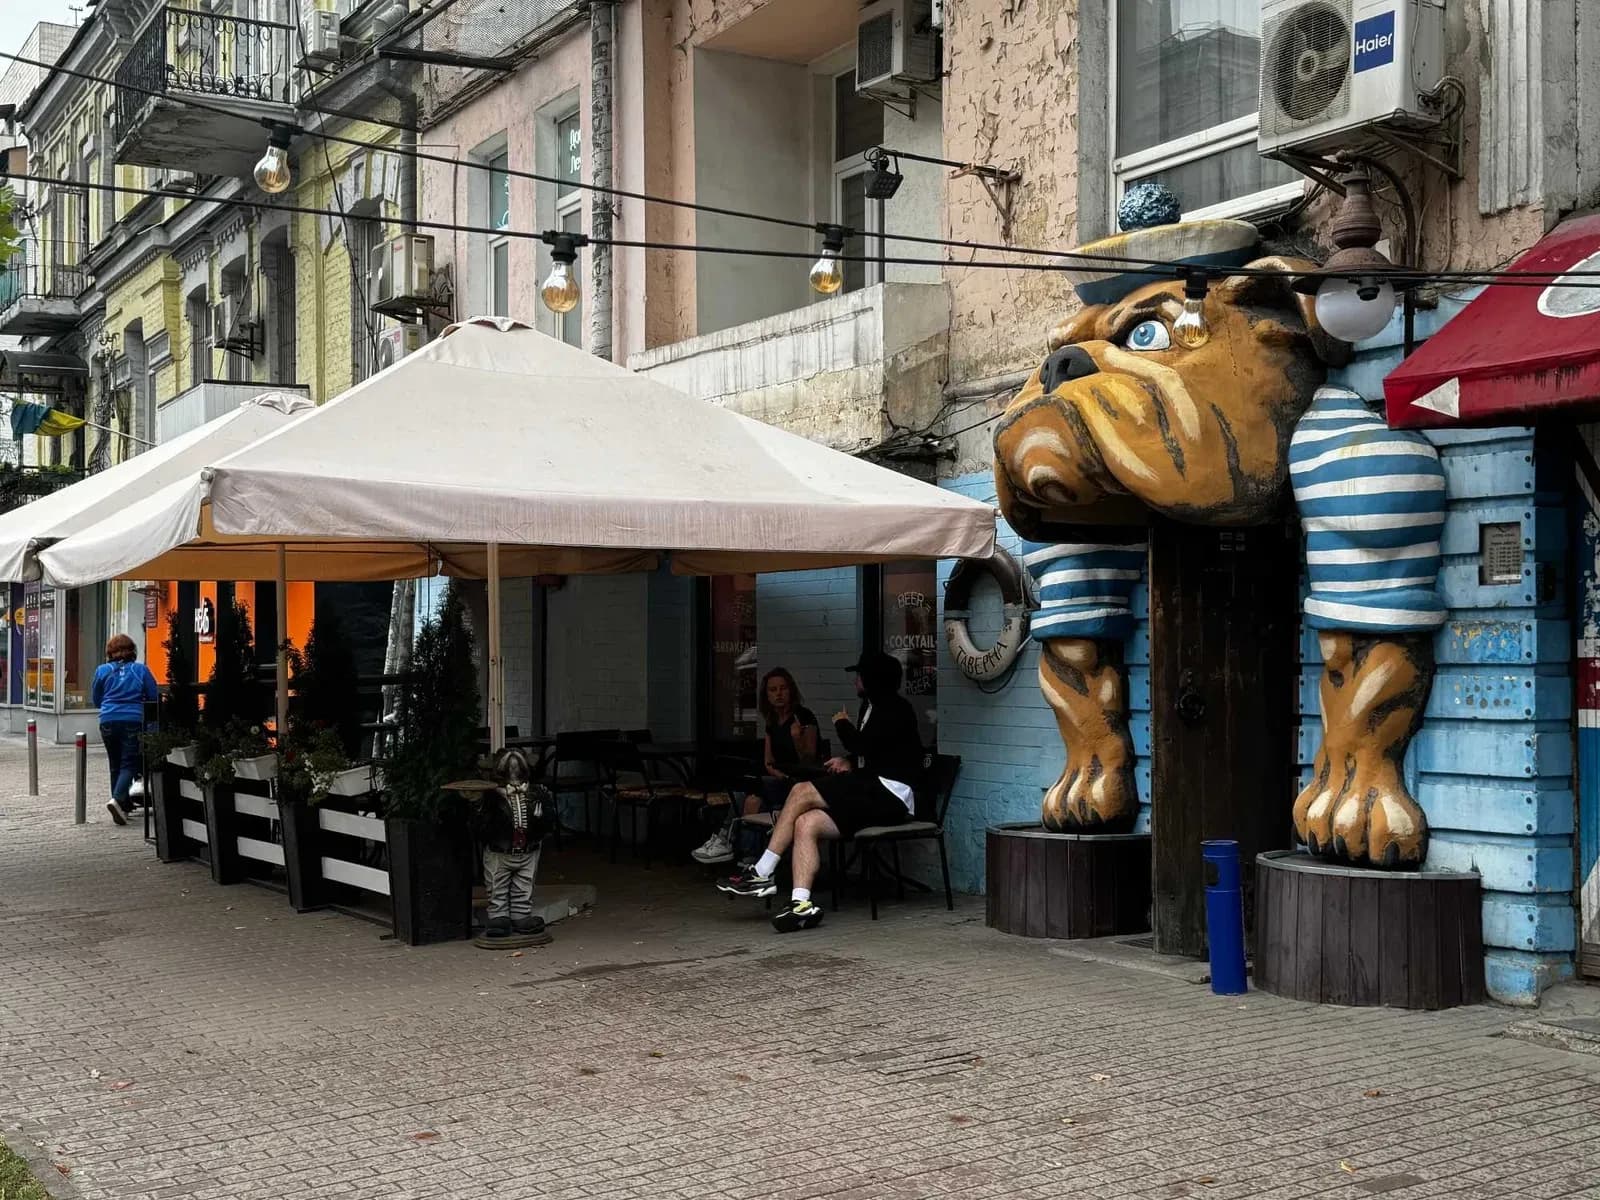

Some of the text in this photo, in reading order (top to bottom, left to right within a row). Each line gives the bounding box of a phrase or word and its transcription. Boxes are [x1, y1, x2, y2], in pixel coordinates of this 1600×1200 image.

[1355, 33, 1393, 56] Haier
[897, 591, 925, 609] BEER
[889, 634, 936, 649] COCKTAIL
[956, 640, 1008, 675] ТАВЕРНА
